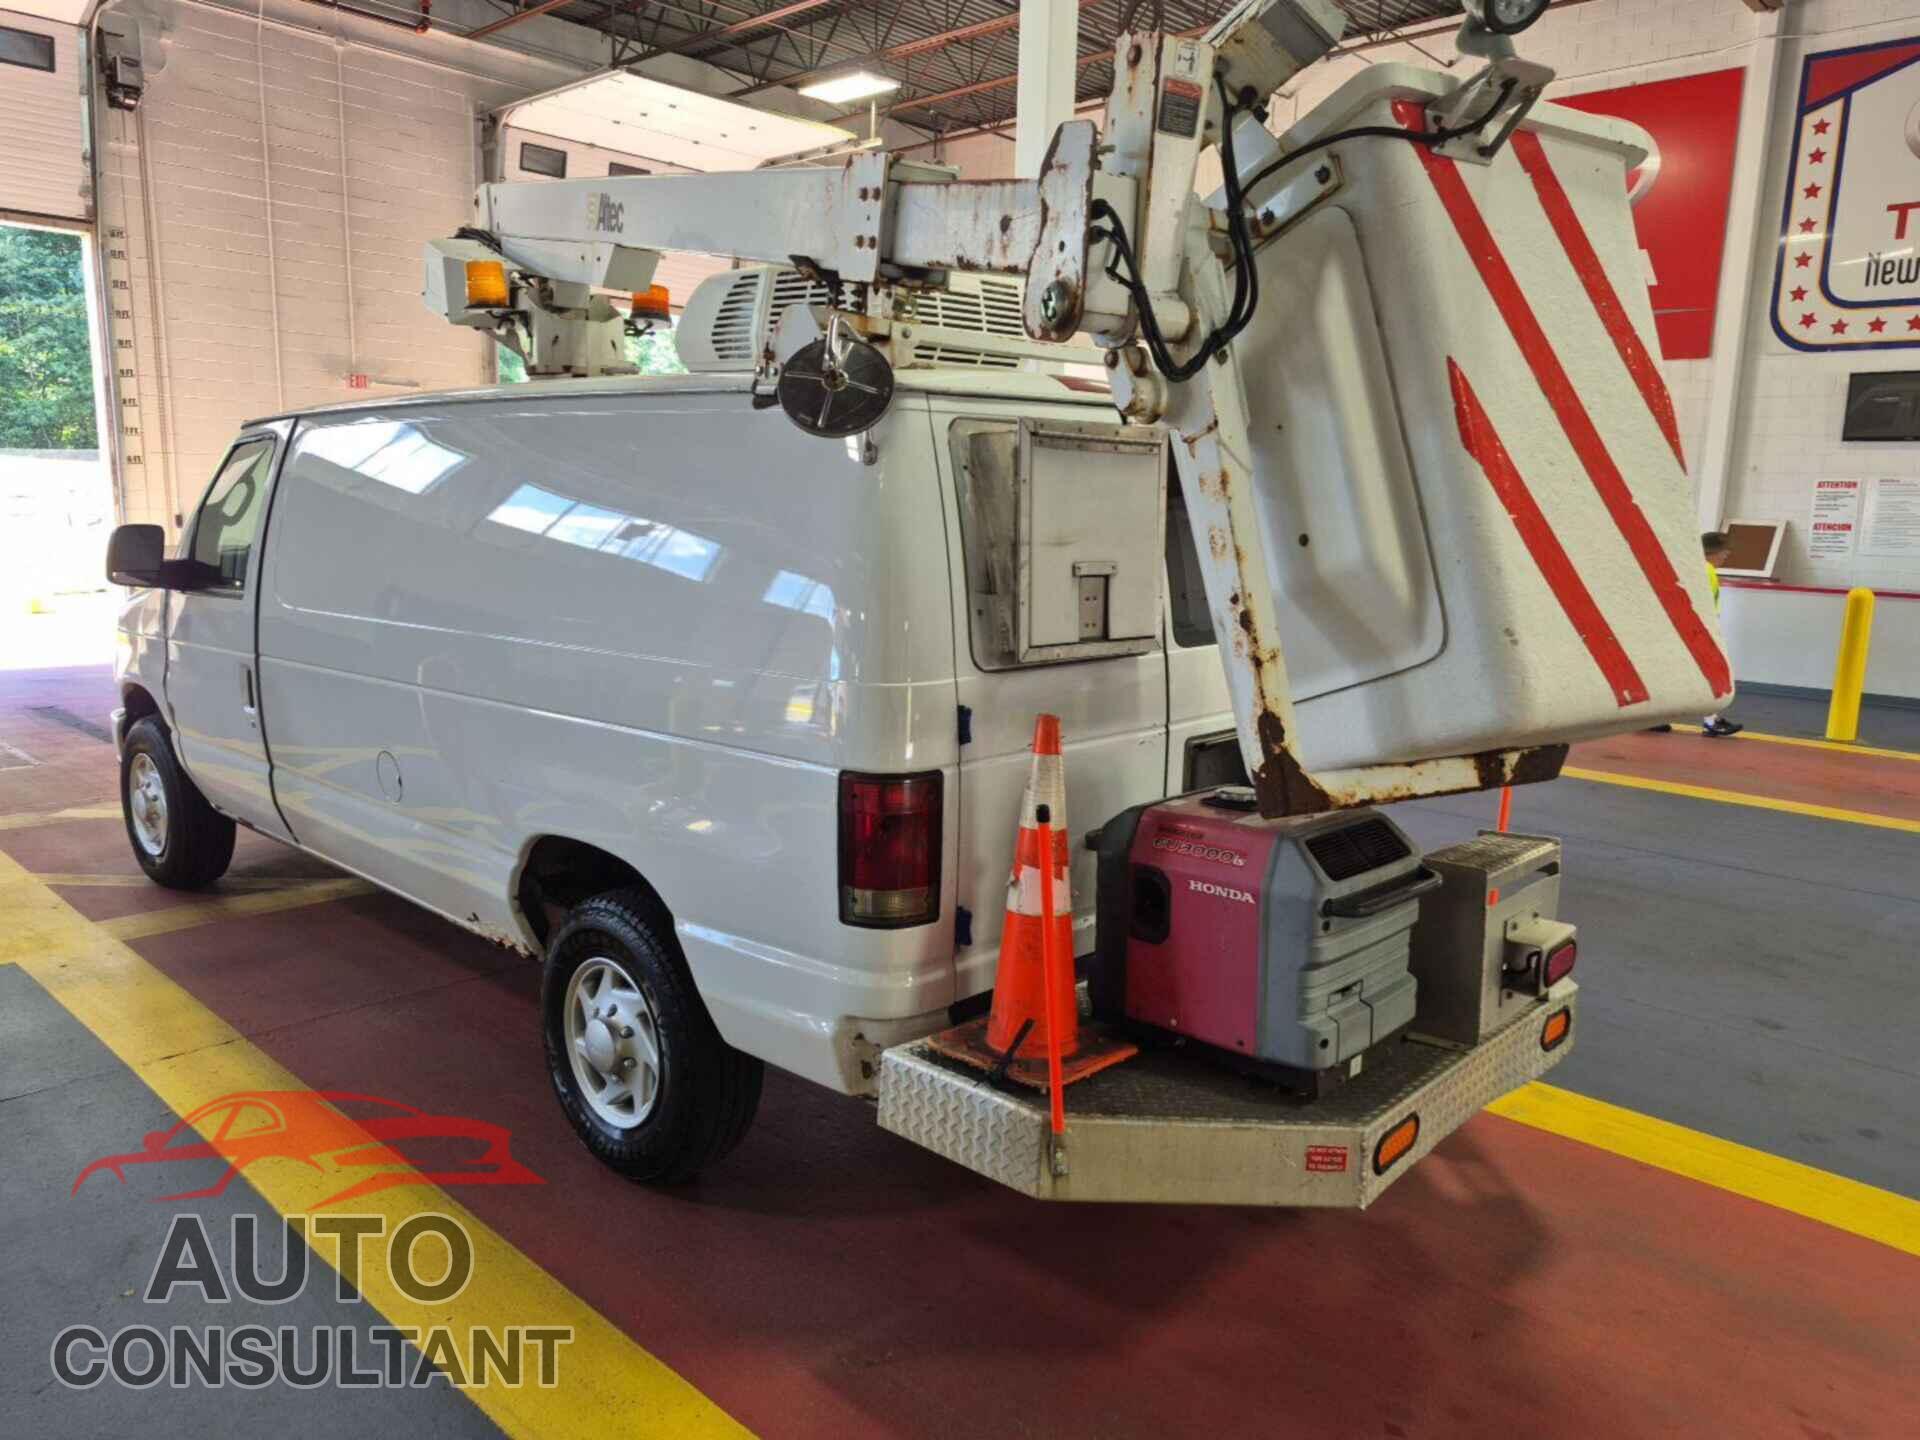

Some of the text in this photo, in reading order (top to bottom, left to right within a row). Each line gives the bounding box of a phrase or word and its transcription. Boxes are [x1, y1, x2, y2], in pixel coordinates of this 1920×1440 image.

[350, 374, 367, 389] EXIT
[1816, 480, 1858, 489] ATTENTION
[1189, 879, 1256, 904] HONDA
